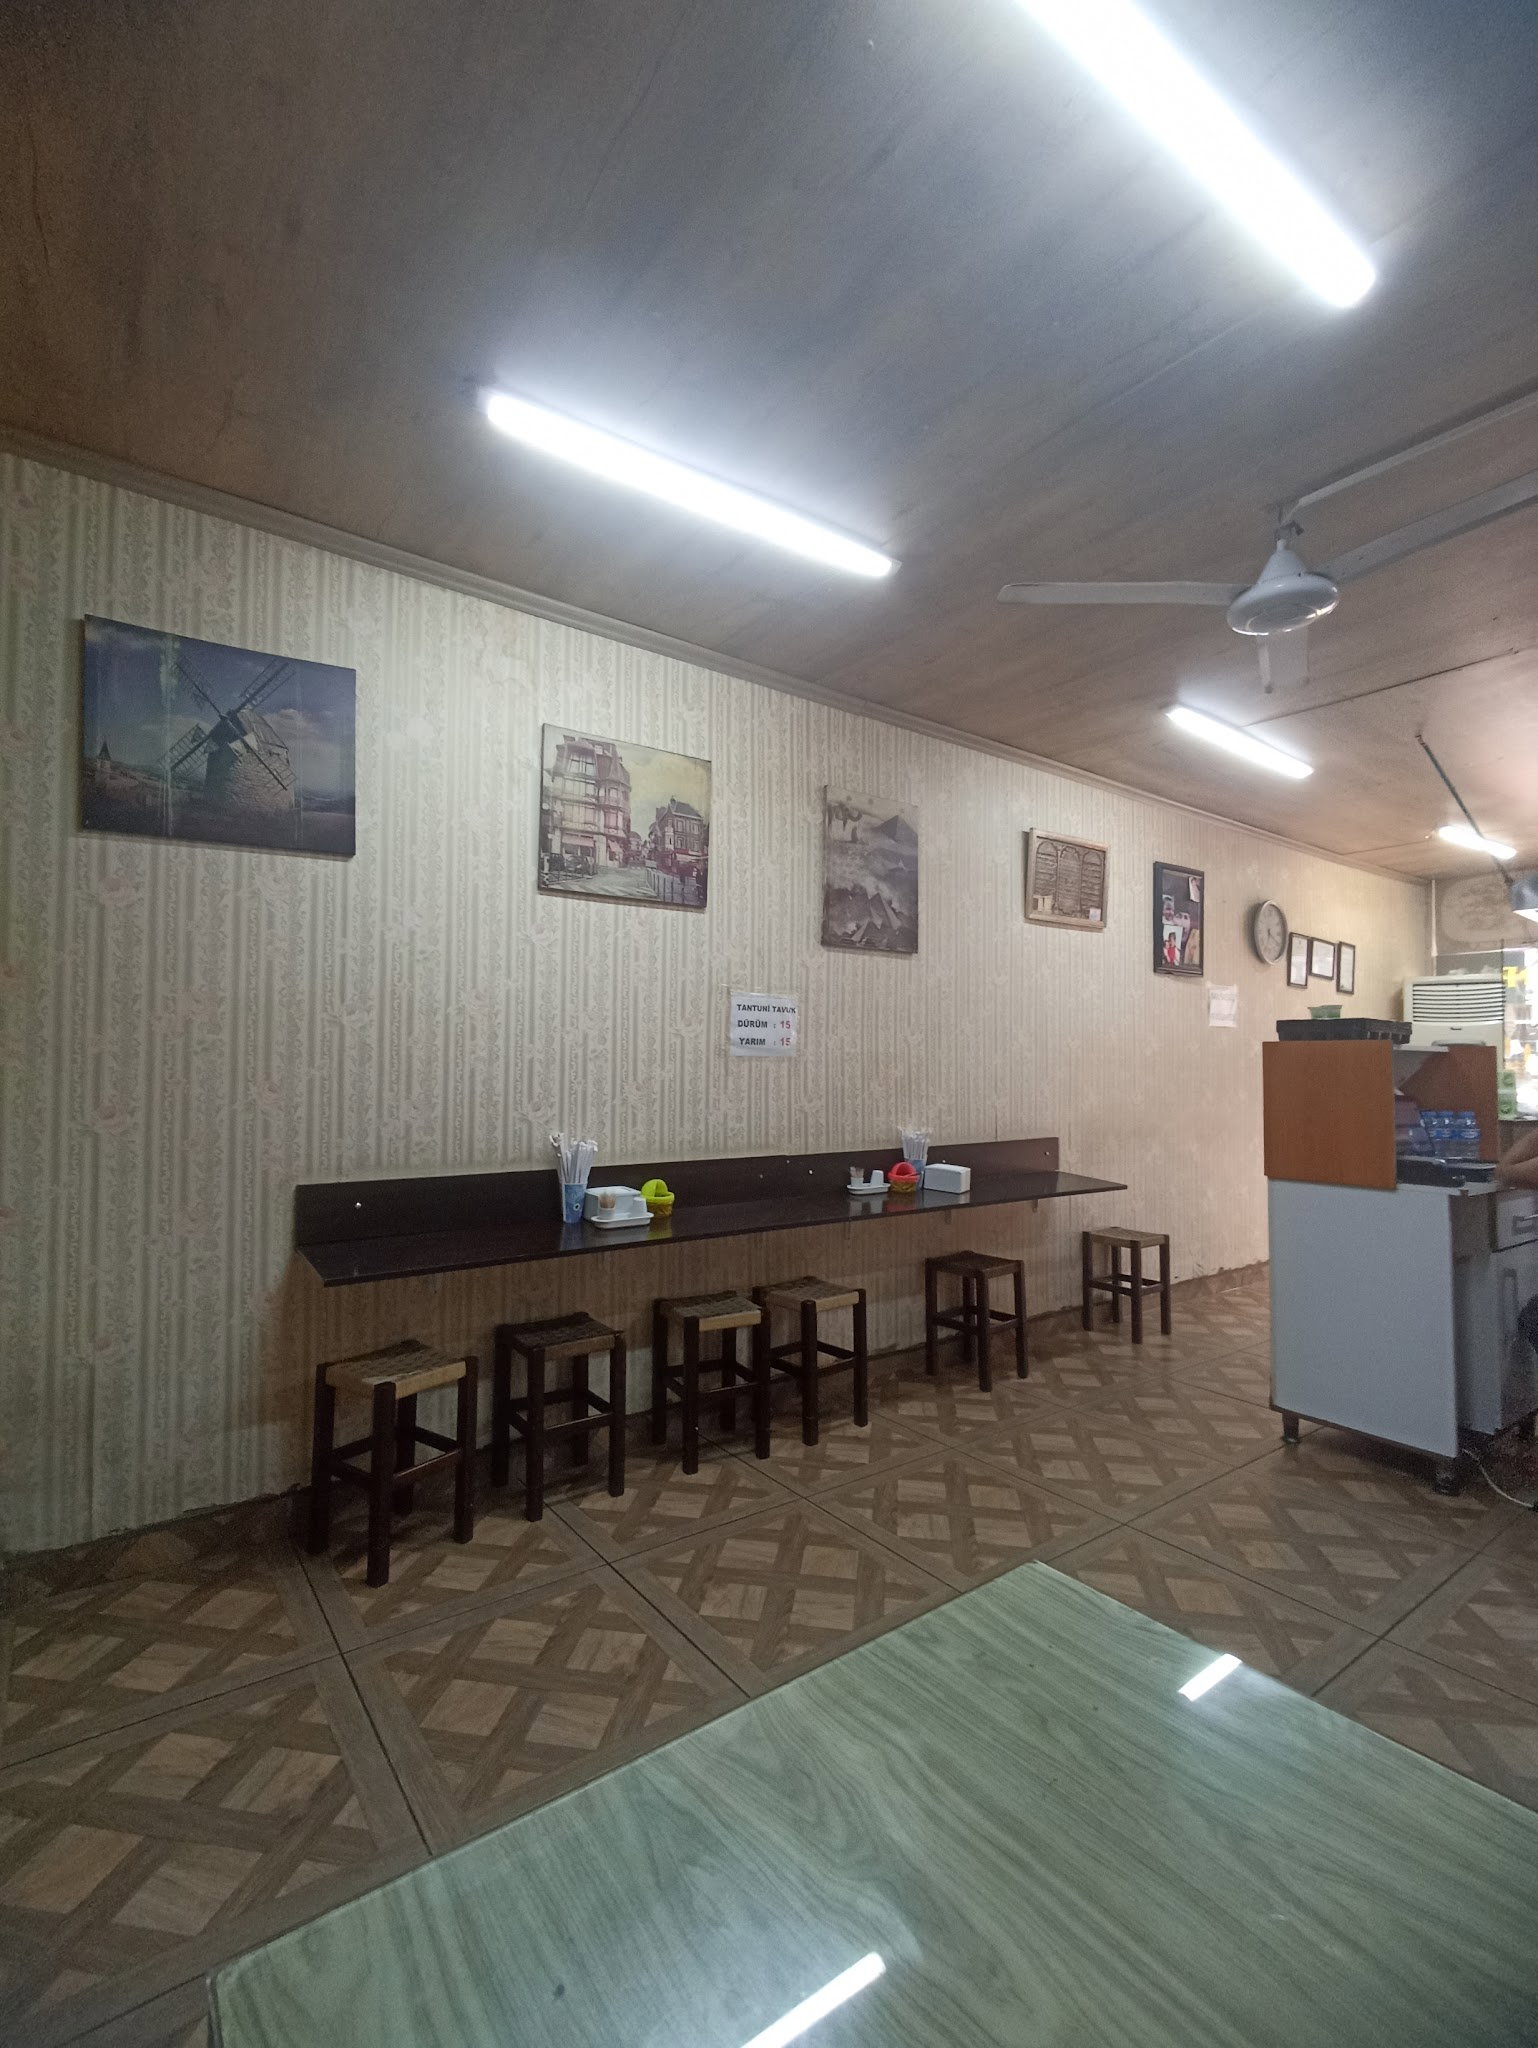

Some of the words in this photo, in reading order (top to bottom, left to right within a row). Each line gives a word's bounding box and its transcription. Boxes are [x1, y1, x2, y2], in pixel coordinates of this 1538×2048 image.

[737, 1019, 768, 1028] DÜRÜM
[780, 1020, 791, 1029] 15
[739, 1037, 766, 1045] YARIM
[780, 1037, 791, 1046] 15
